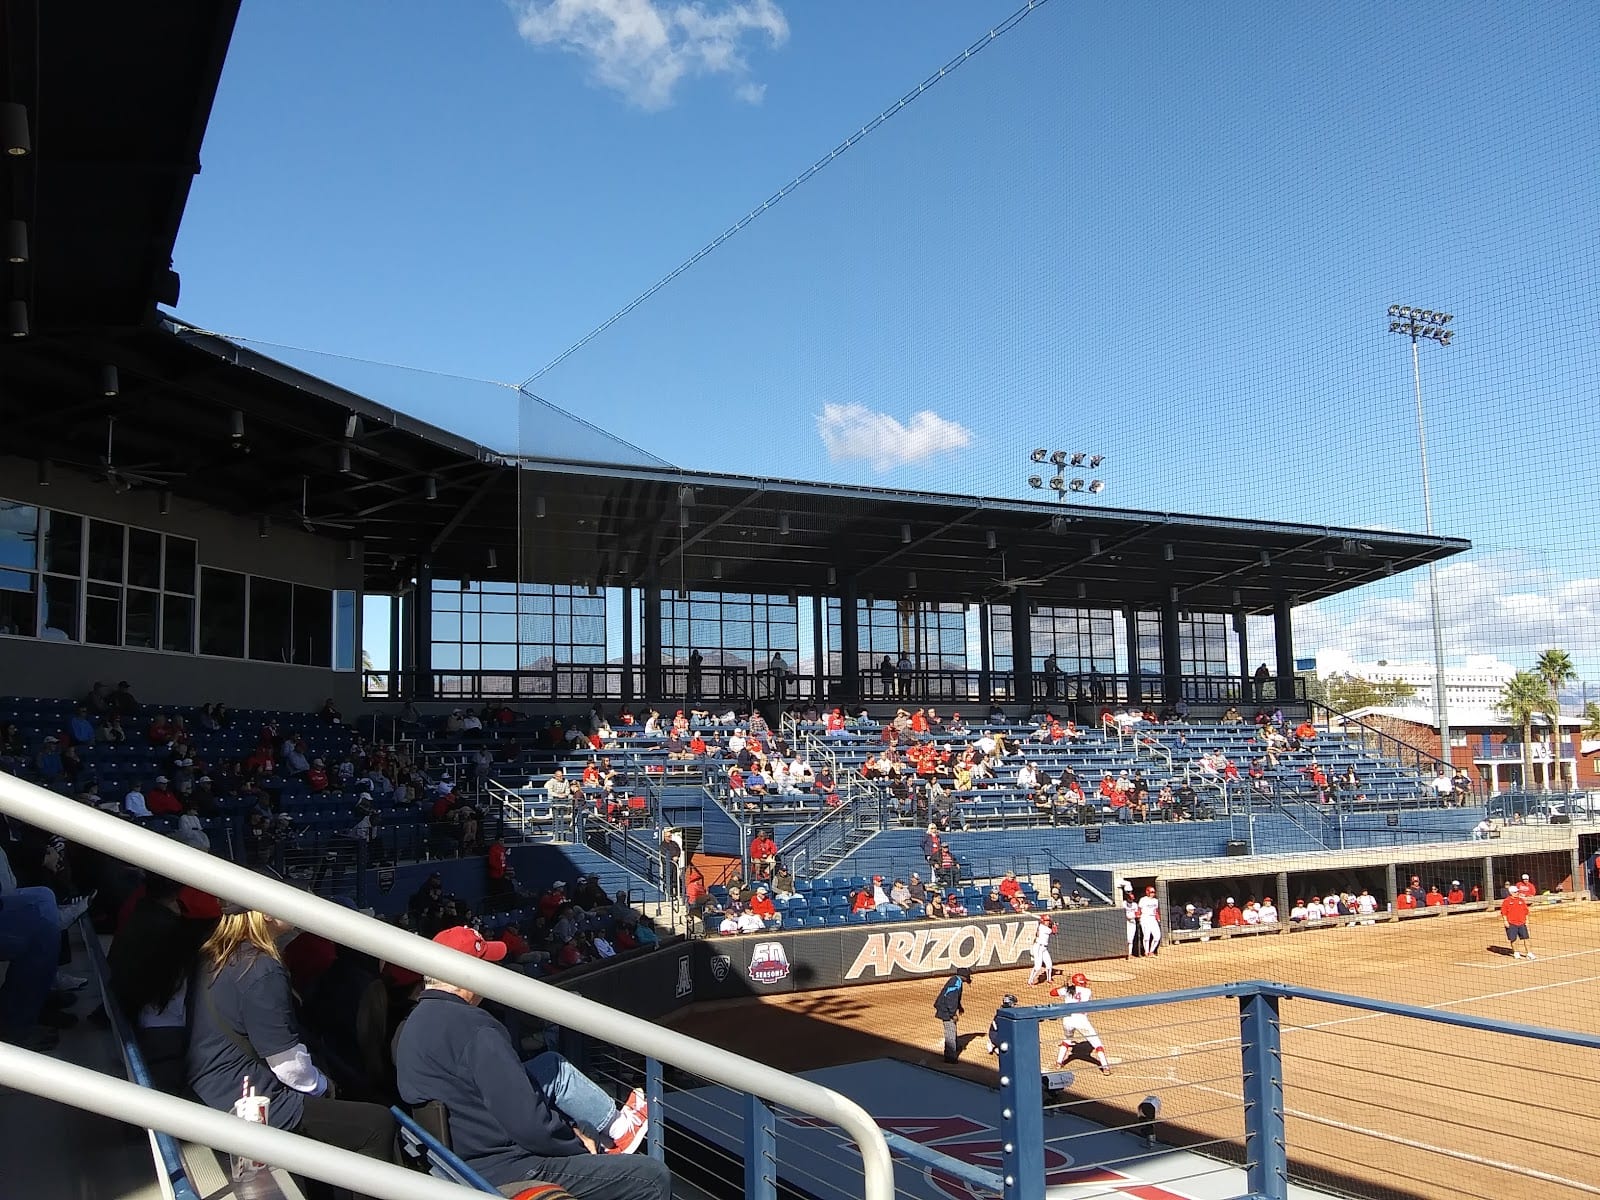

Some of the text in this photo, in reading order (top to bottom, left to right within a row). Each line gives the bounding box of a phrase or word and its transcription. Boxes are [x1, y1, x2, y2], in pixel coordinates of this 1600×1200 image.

[753, 942, 786, 967] 50
[844, 920, 1039, 980] ARIZONA
[755, 969, 784, 978] SEASONS
